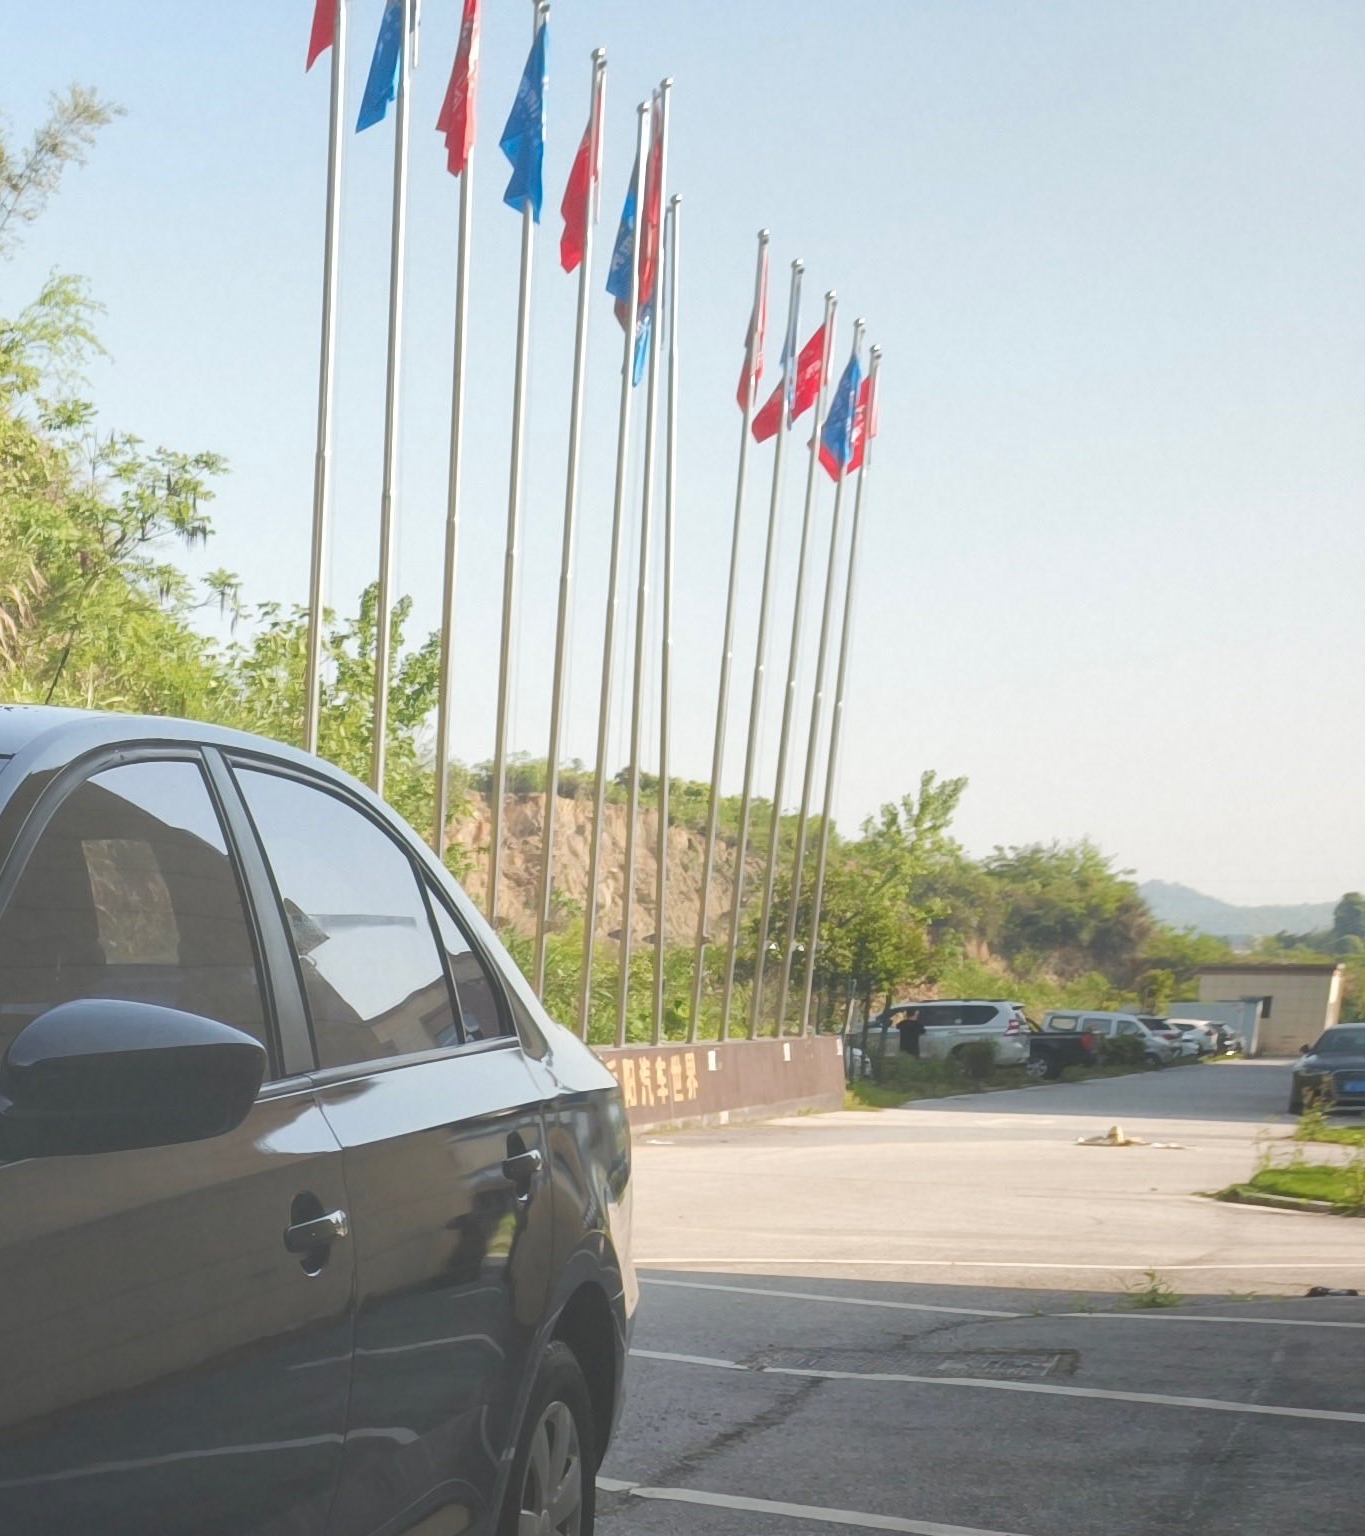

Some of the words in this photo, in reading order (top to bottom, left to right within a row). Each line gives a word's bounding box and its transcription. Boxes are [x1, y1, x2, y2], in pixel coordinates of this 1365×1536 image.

[606, 1052, 699, 1109] 阳汽车世界
